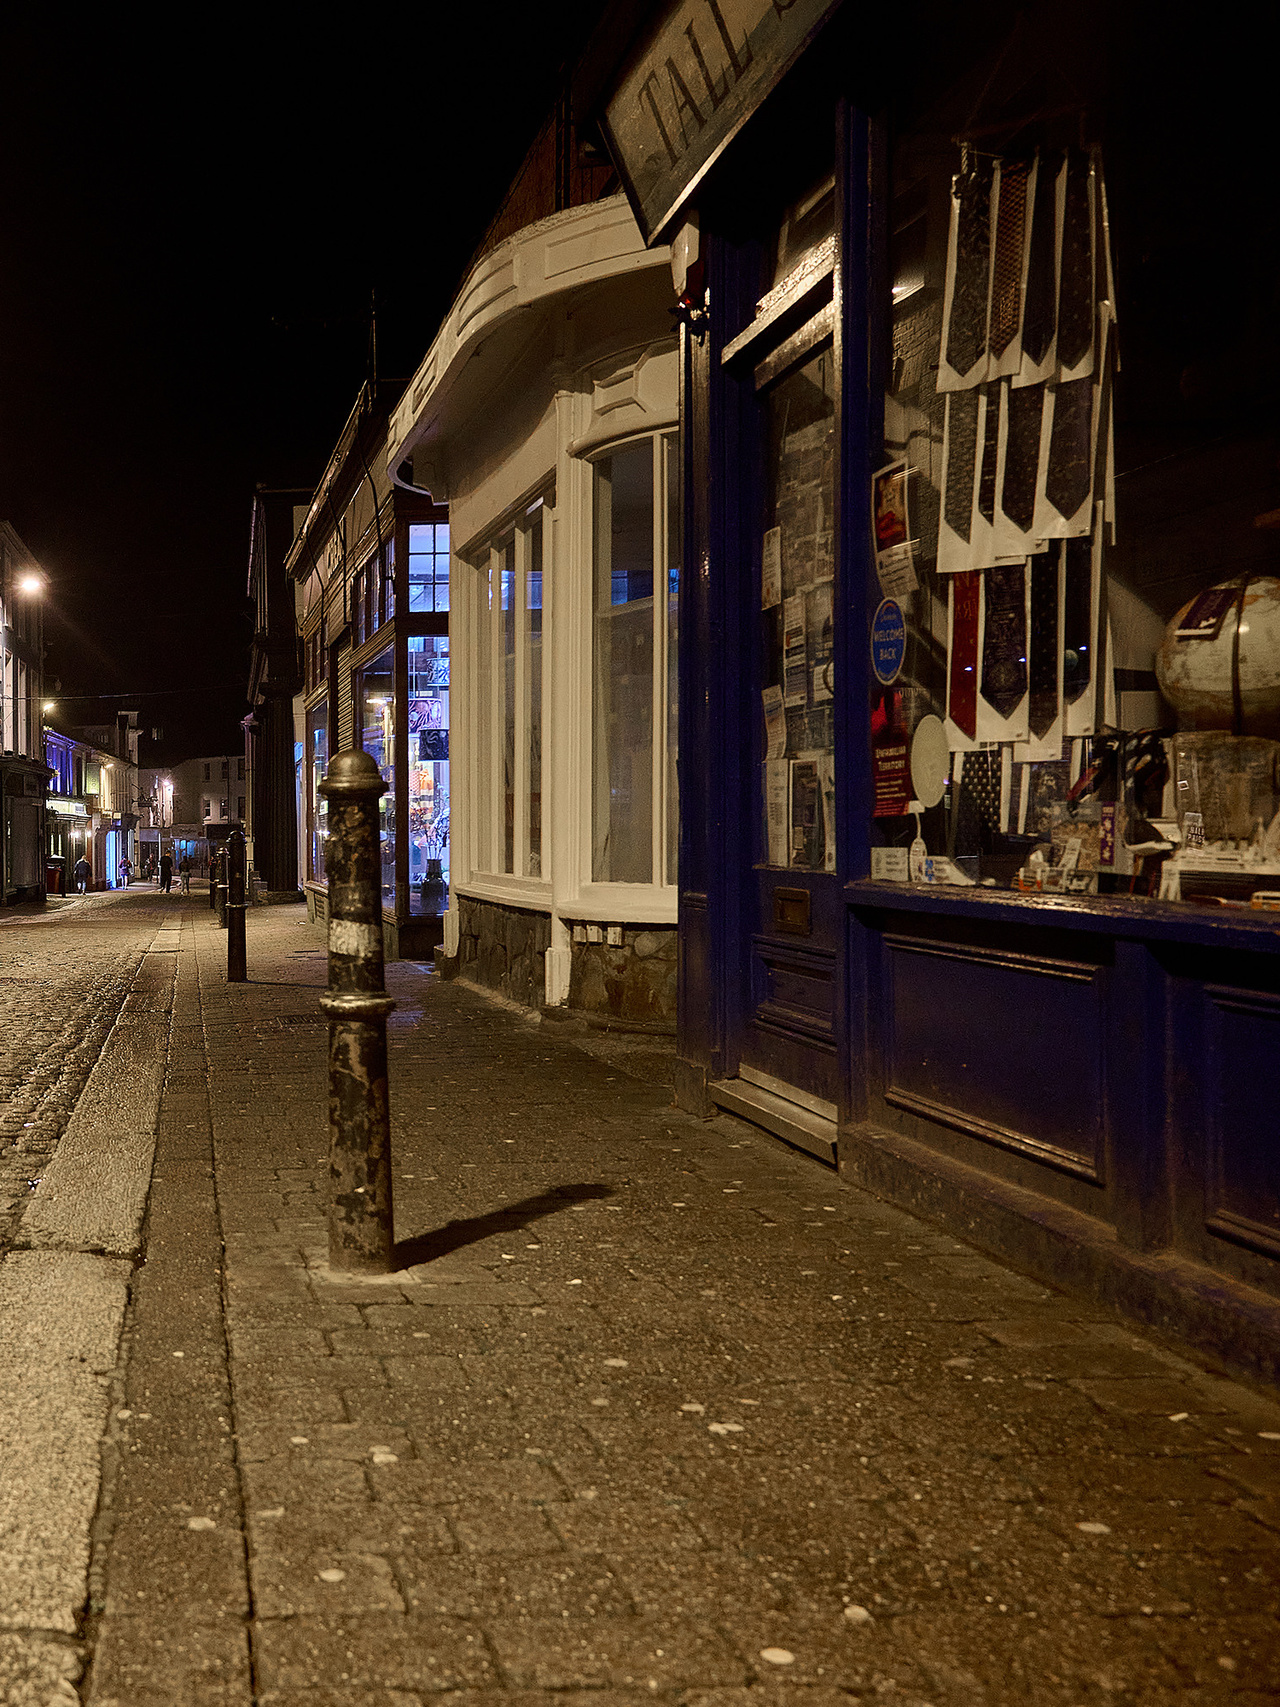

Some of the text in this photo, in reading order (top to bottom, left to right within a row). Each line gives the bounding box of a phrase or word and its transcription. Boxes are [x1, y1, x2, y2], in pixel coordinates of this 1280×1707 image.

[638, 0, 754, 170] TALL
[873, 628, 905, 643] WELCOME
[879, 648, 897, 660] BACK
